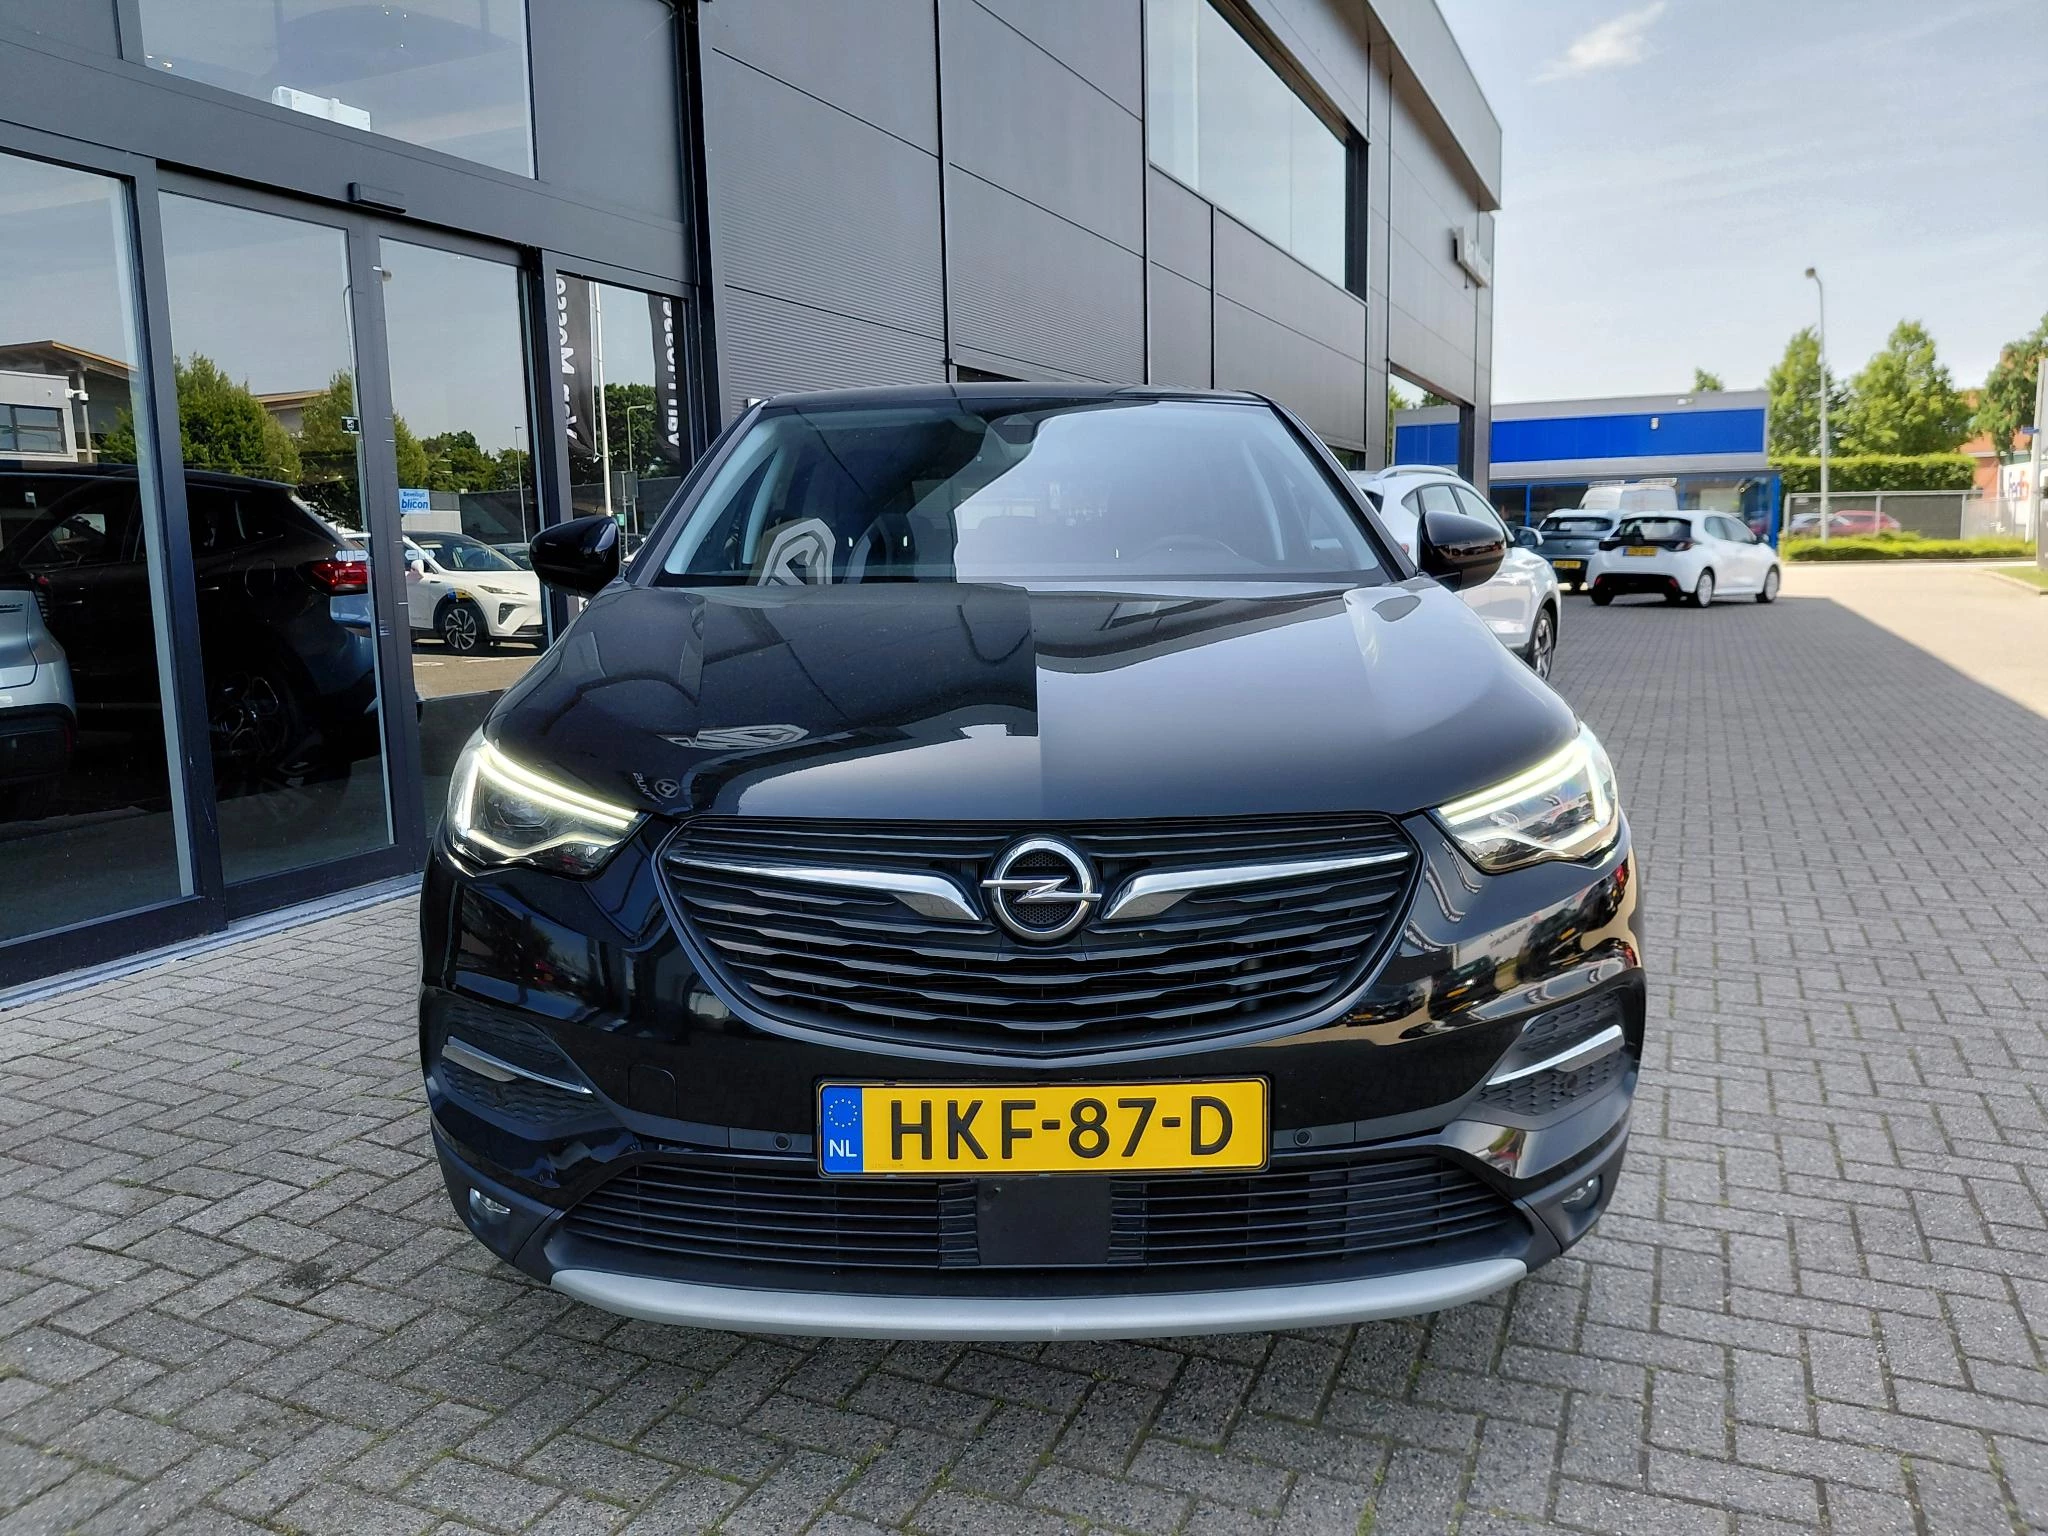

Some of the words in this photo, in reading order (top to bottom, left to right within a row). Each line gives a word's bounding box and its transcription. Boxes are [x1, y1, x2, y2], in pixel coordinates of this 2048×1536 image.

[401, 498, 428, 509] blicon
[890, 1096, 1233, 1161] HKF-87-D
[829, 1138, 858, 1158] NL
